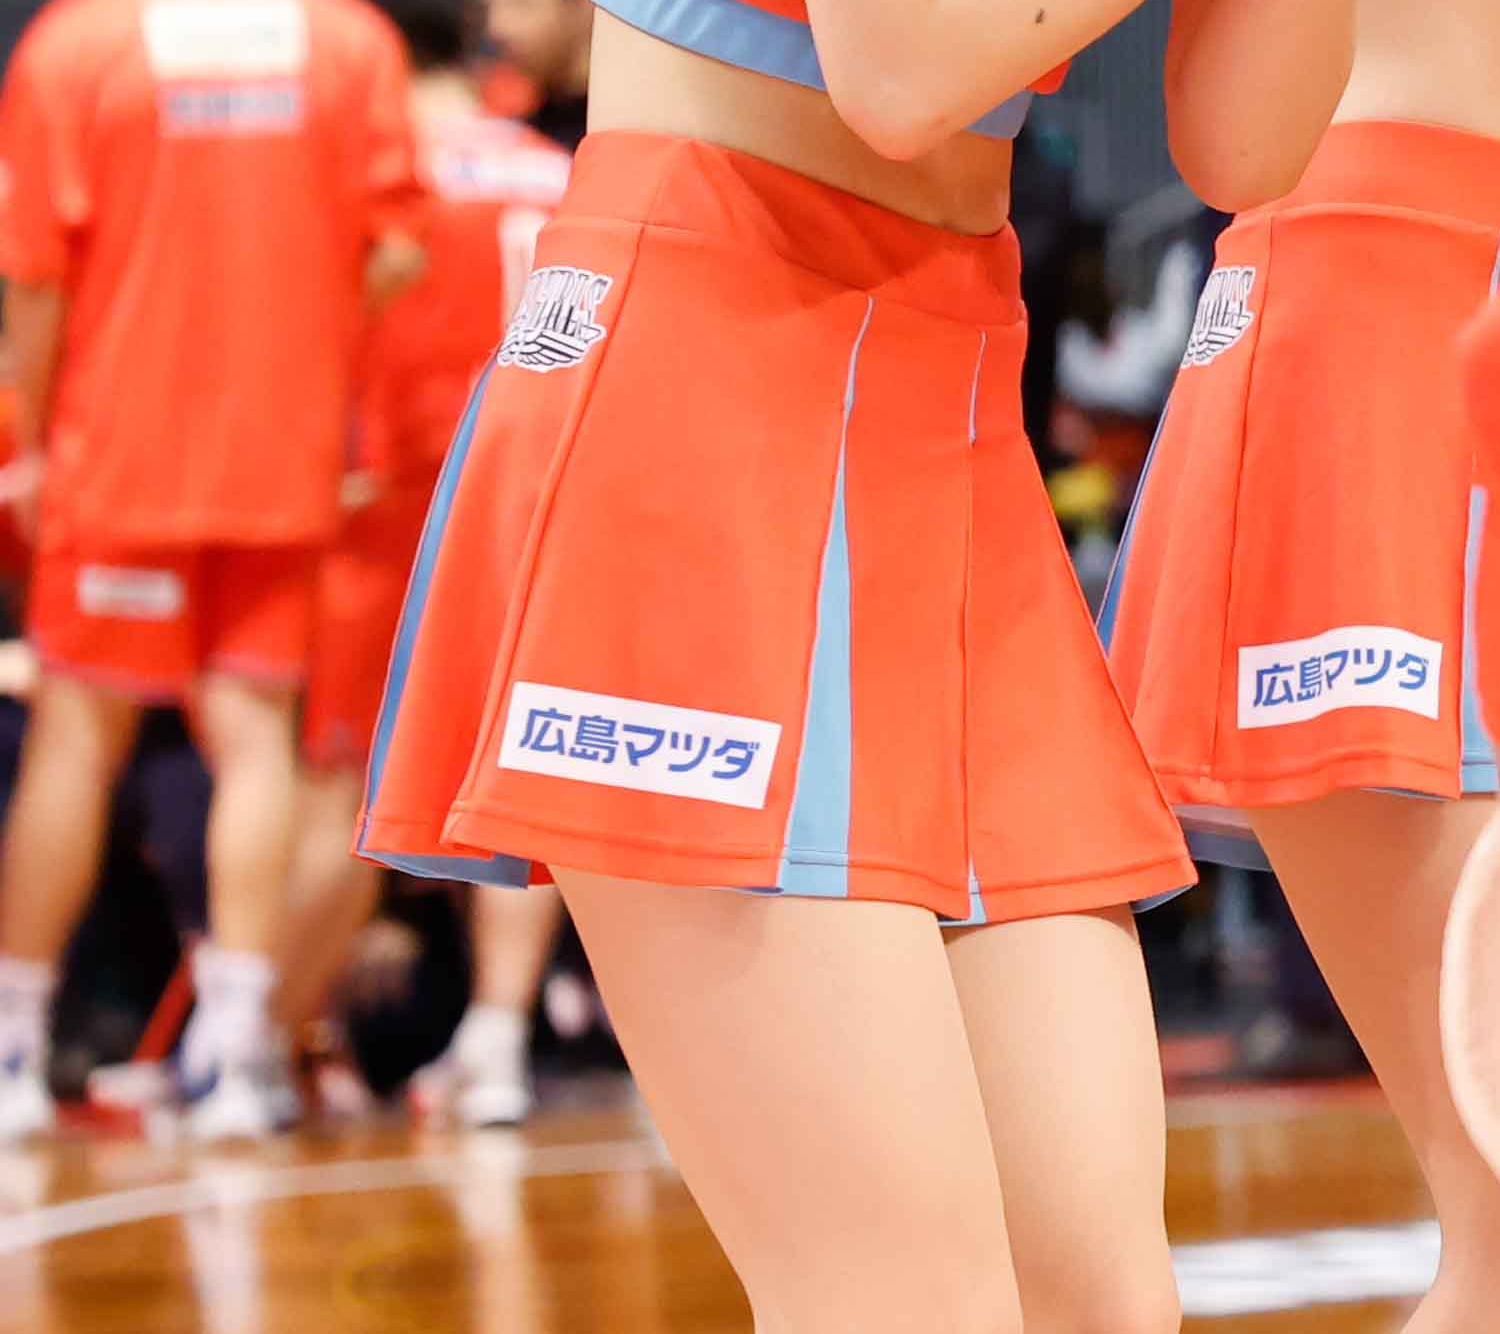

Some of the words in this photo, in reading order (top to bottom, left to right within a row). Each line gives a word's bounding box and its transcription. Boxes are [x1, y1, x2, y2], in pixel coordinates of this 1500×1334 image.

[1253, 648, 1429, 707] 広島マツダ
[519, 707, 760, 780] 広島マツダ
